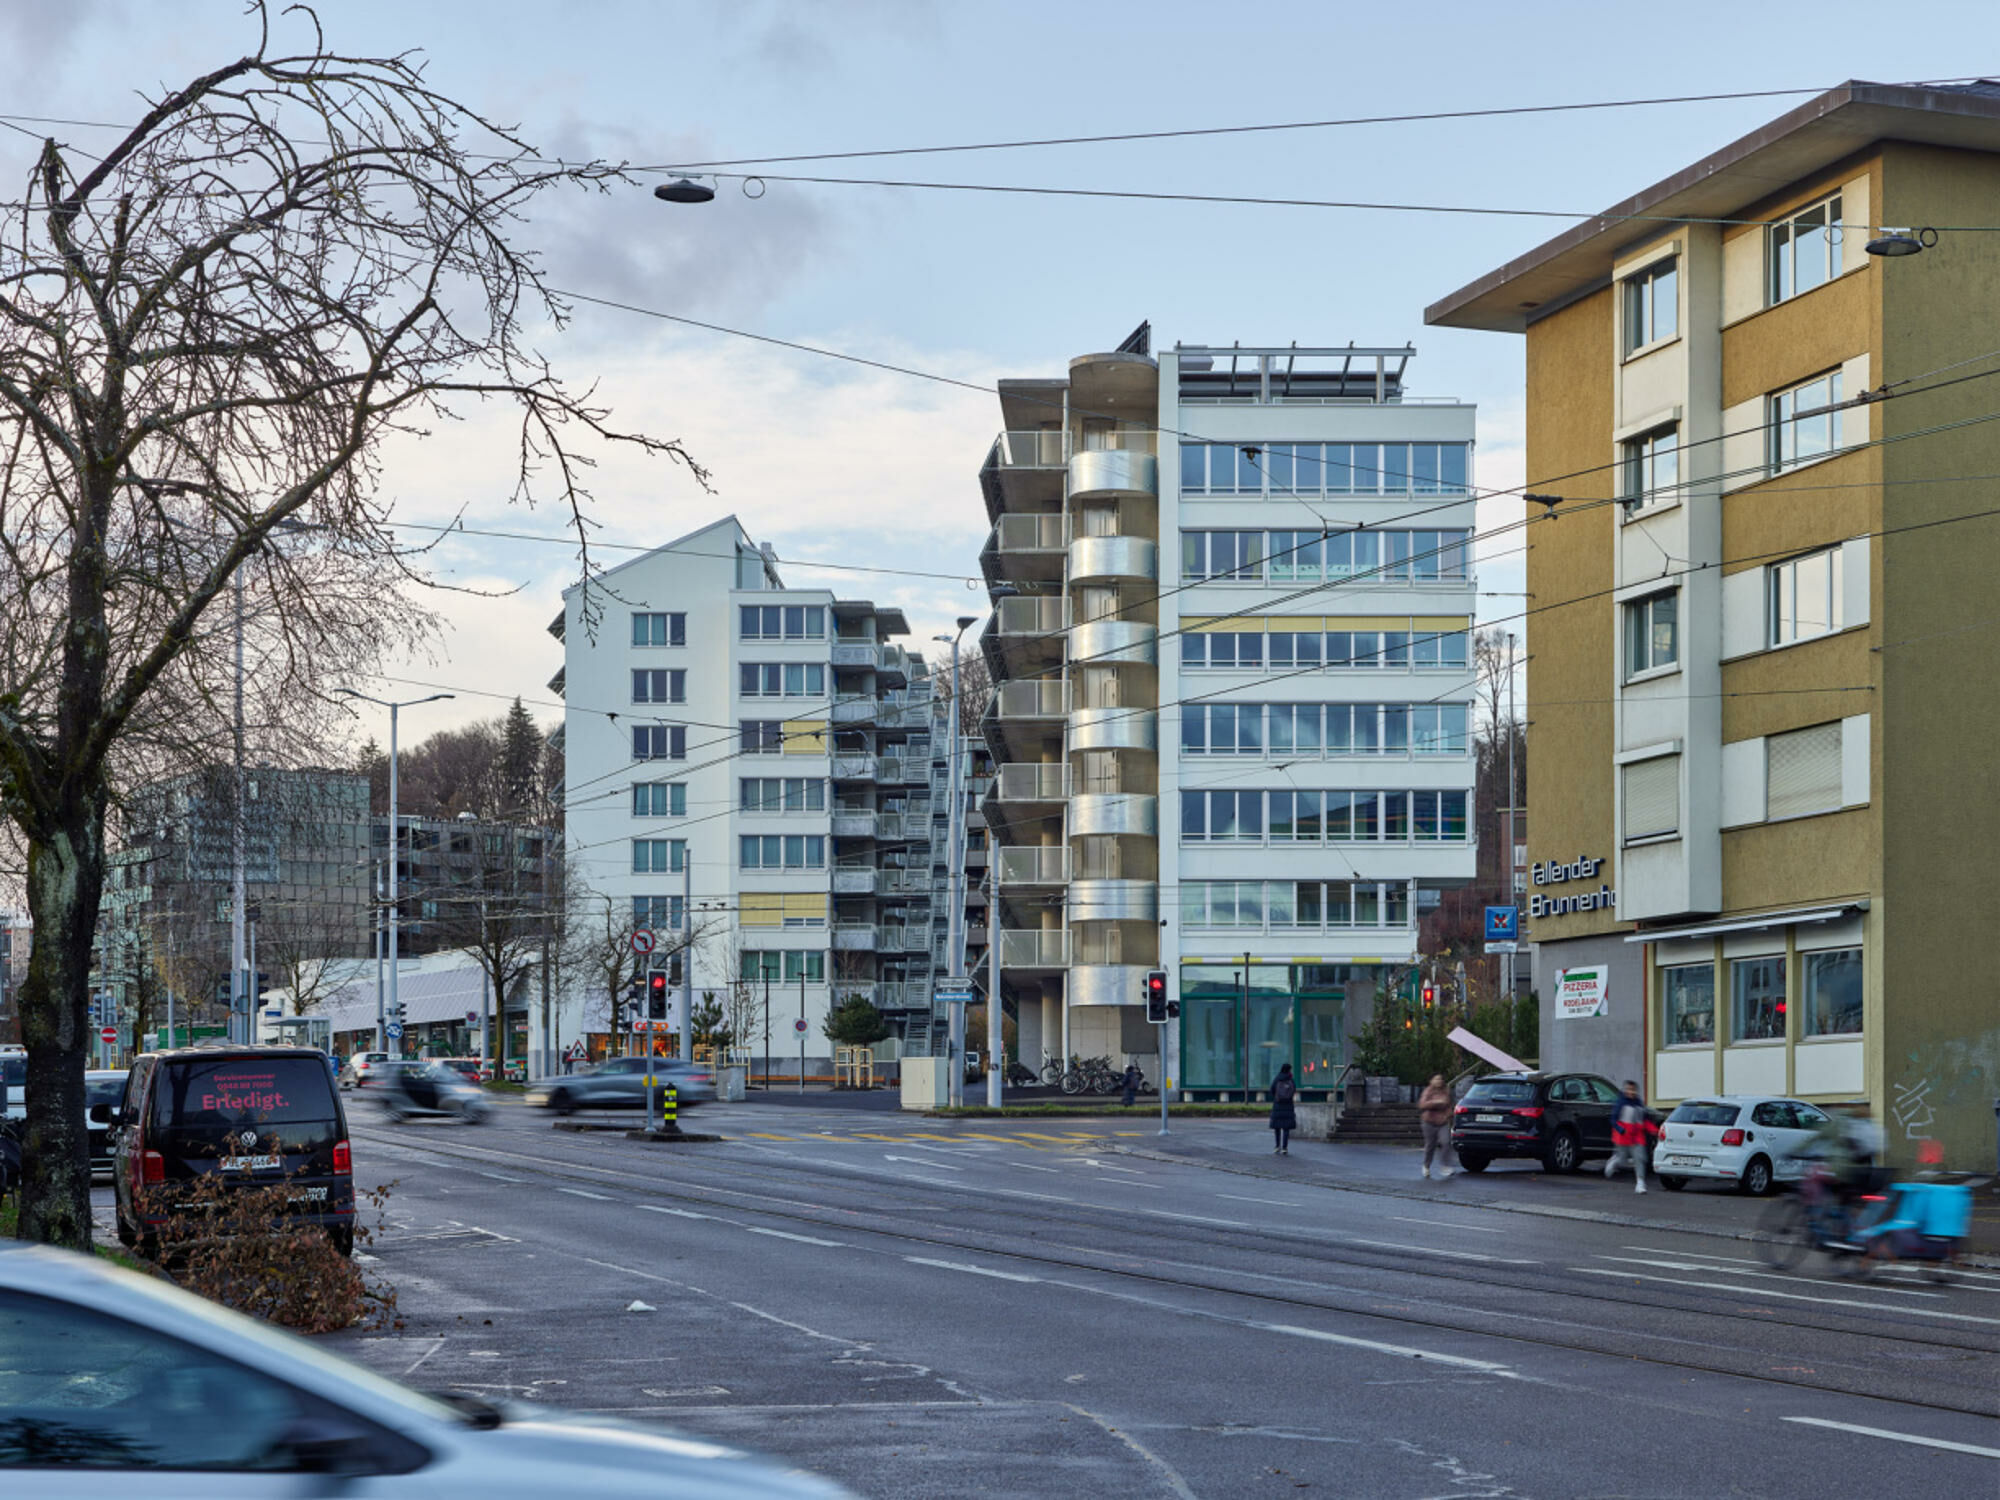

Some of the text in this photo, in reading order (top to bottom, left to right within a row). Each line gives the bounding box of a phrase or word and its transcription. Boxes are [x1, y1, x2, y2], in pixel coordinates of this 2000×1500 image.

[1531, 855, 1604, 886] fallender
[1563, 981, 1598, 992] PIZZERIA
[202, 1091, 289, 1110] Erledigt.
